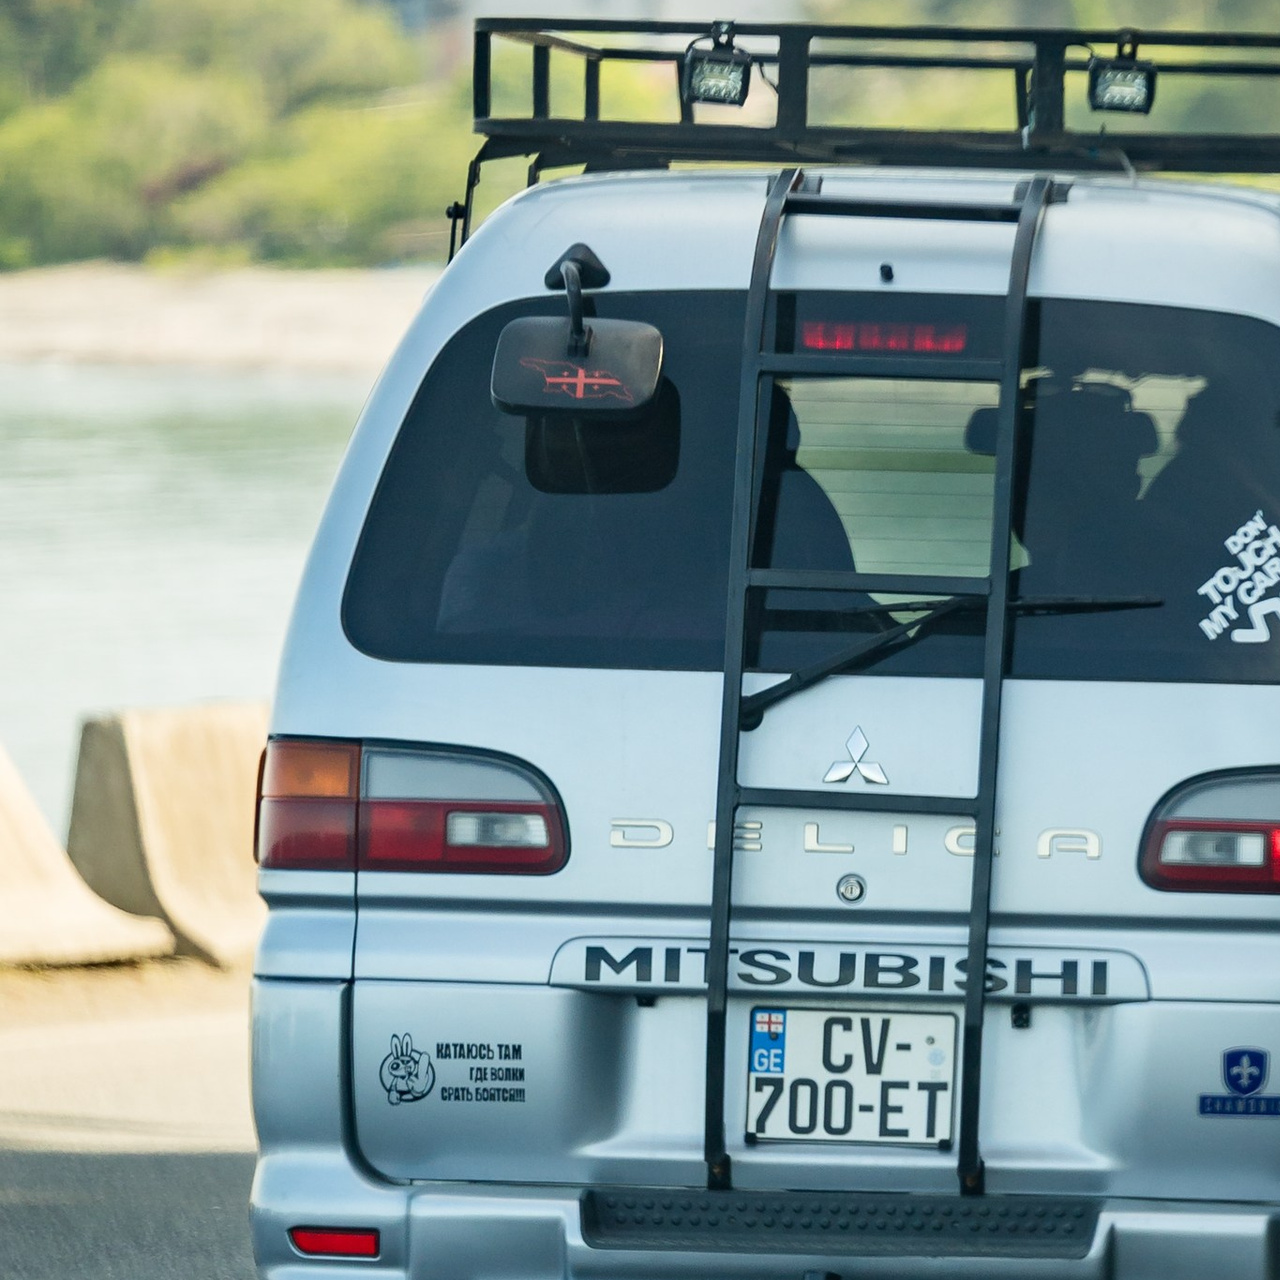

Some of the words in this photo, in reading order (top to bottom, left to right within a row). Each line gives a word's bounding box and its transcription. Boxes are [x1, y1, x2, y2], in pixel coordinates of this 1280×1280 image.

[1198, 594, 1239, 641] MY
[609, 818, 1104, 860] DELICA
[436, 1043, 494, 1060] КАТАЮСЬ
[497, 1044, 522, 1060] ТАМ
[753, 1049, 782, 1072] GE
[469, 1066, 488, 1083] ГДЕ
[490, 1067, 525, 1082] ВОЛКИ
[441, 1086, 473, 1101] СРАТЬ
[475, 1087, 526, 1102] БОЯТСЯ!!!
[755, 1077, 948, 1138] 700-ET
